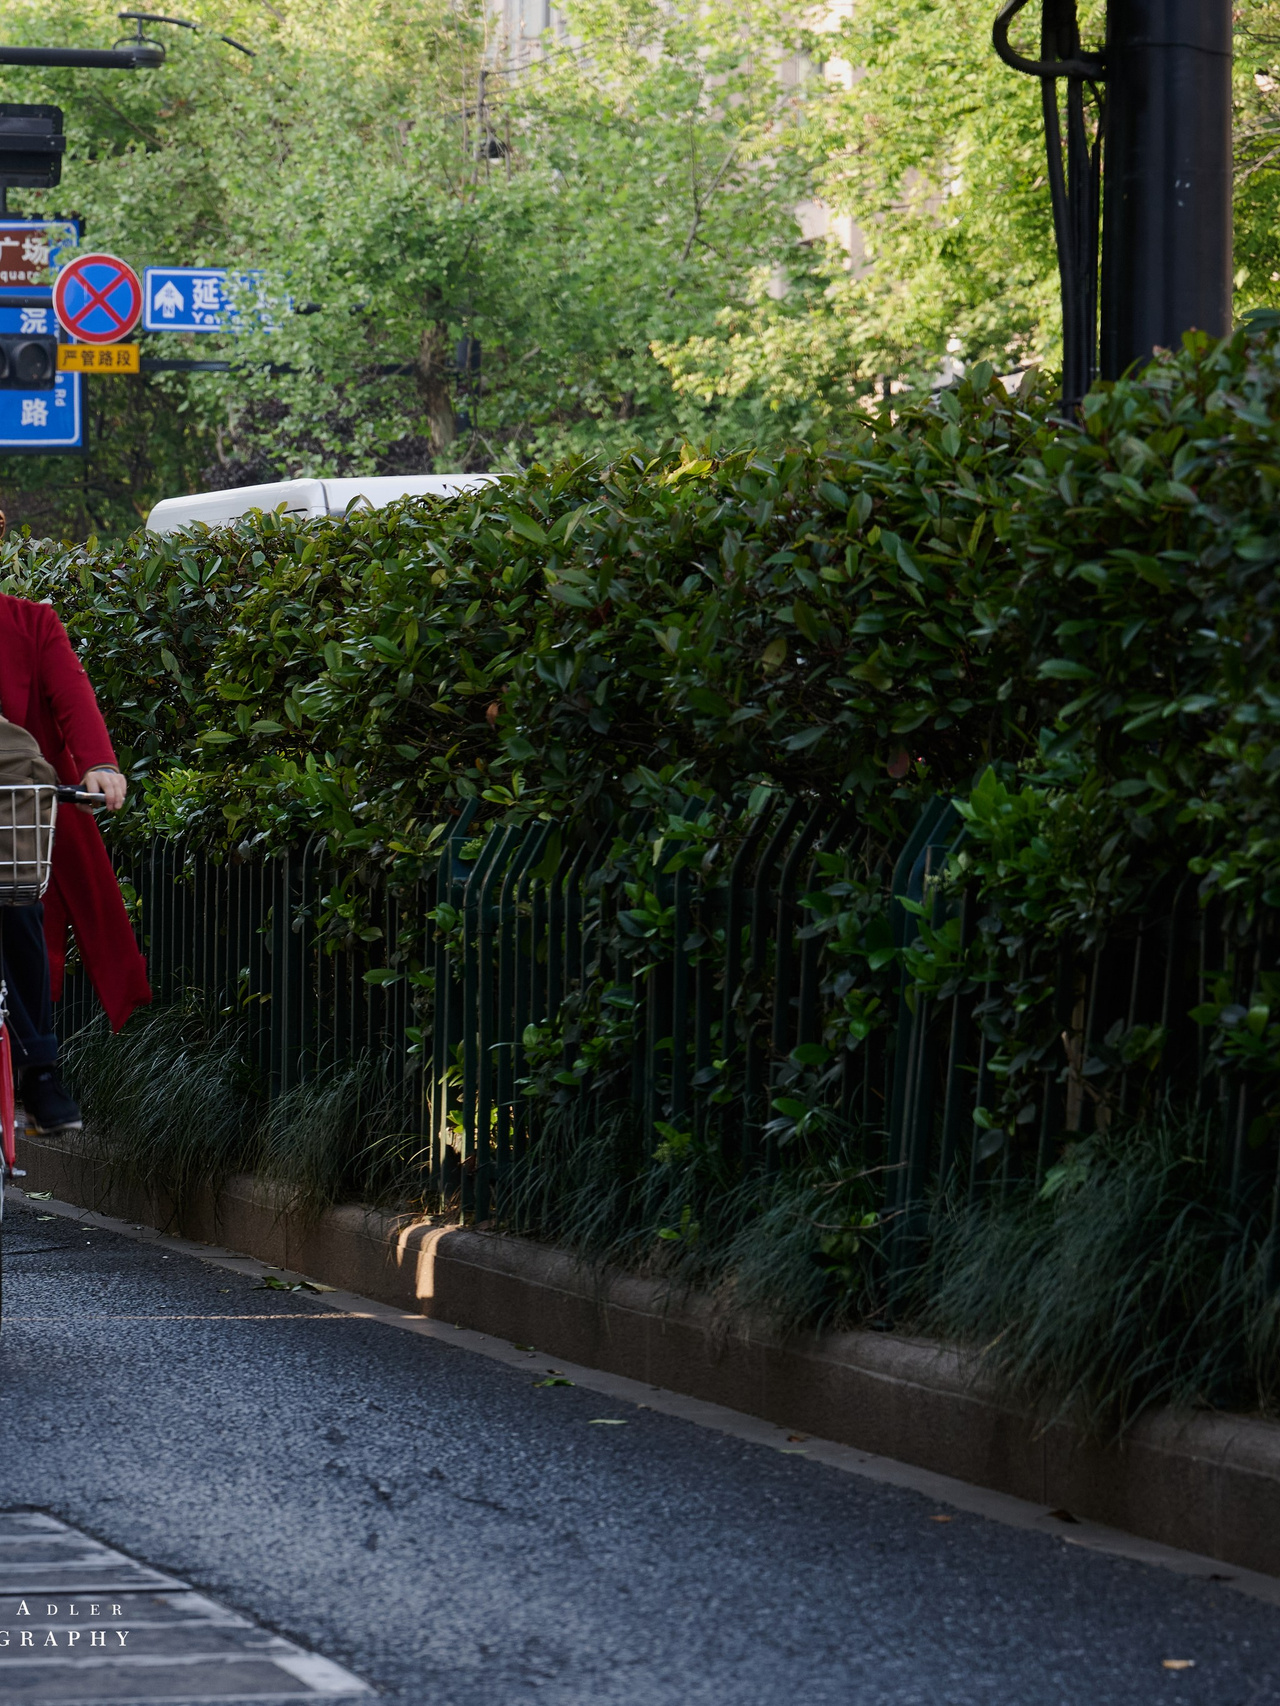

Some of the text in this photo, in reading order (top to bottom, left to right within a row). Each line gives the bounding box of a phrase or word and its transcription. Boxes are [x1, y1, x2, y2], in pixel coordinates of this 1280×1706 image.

[19, 308, 49, 427] 浣路
[62, 349, 131, 367] 严管路段
[55, 388, 67, 407] Rd
